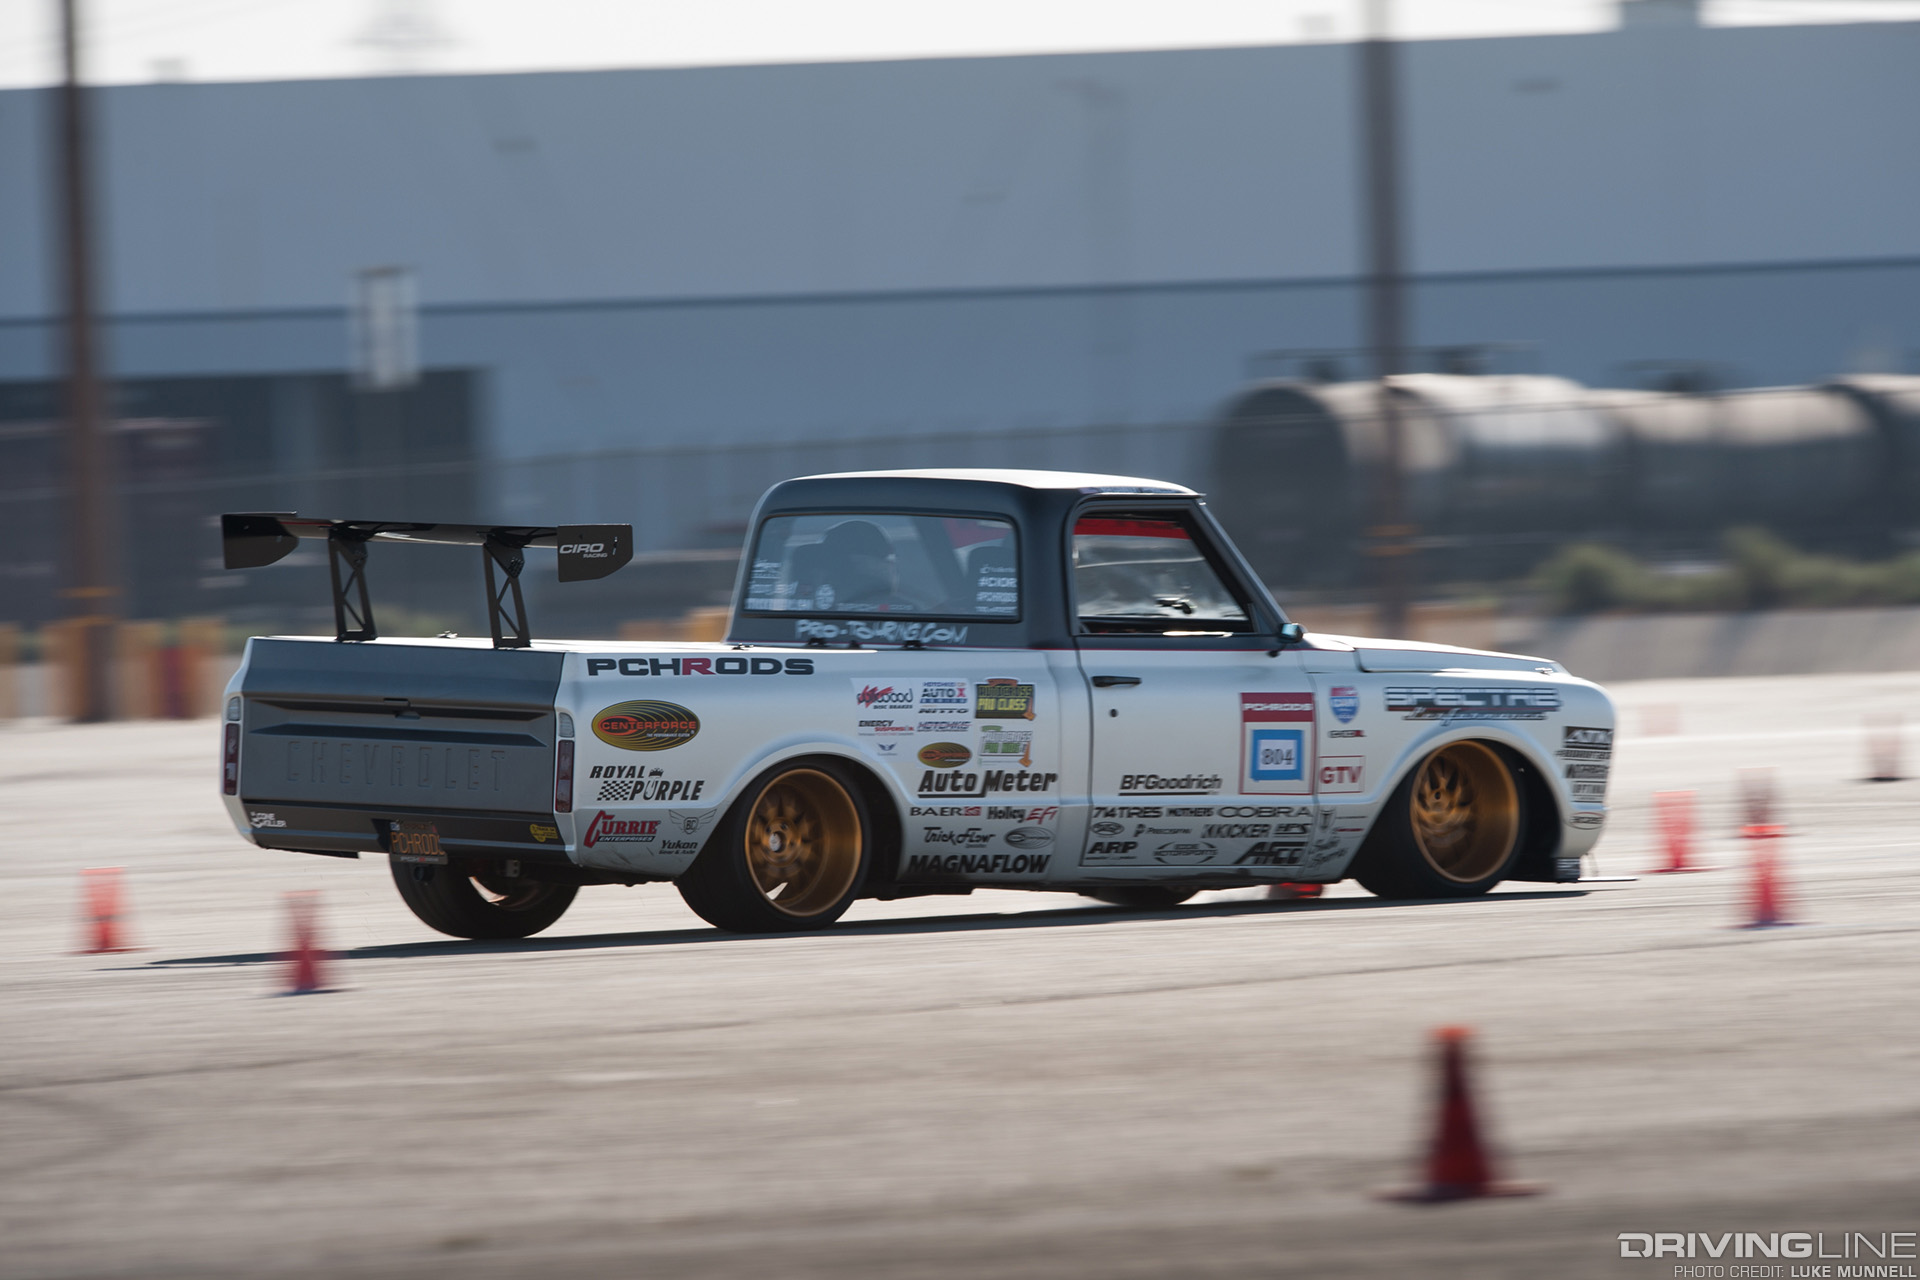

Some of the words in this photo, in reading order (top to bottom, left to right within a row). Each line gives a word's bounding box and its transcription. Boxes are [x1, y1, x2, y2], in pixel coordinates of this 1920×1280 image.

[560, 543, 604, 554] CIRO
[587, 657, 814, 676] PCHRODS
[921, 688, 956, 697] AUTO
[956, 688, 966, 697] X
[1384, 687, 1560, 707] SPECTRE
[997, 698, 1027, 710] CLASS
[601, 720, 697, 730] CENTERFORCE
[1260, 748, 1295, 766] 804
[287, 740, 506, 791] CHEVROLET
[589, 765, 646, 778] ROYAL
[917, 770, 978, 792] Auto
[983, 770, 1058, 793] Meter
[1119, 774, 1223, 790] BFGoodrich
[1319, 766, 1363, 784] GTV
[628, 780, 705, 801] PURPLE
[910, 807, 964, 816] BAER
[987, 806, 1026, 823] Holley
[1218, 806, 1313, 818] COBRA
[583, 810, 662, 848] CURRIE
[661, 840, 698, 850] Yukon
[1088, 842, 1138, 854] ARP
[908, 854, 1052, 874] MAGNAFLOW
